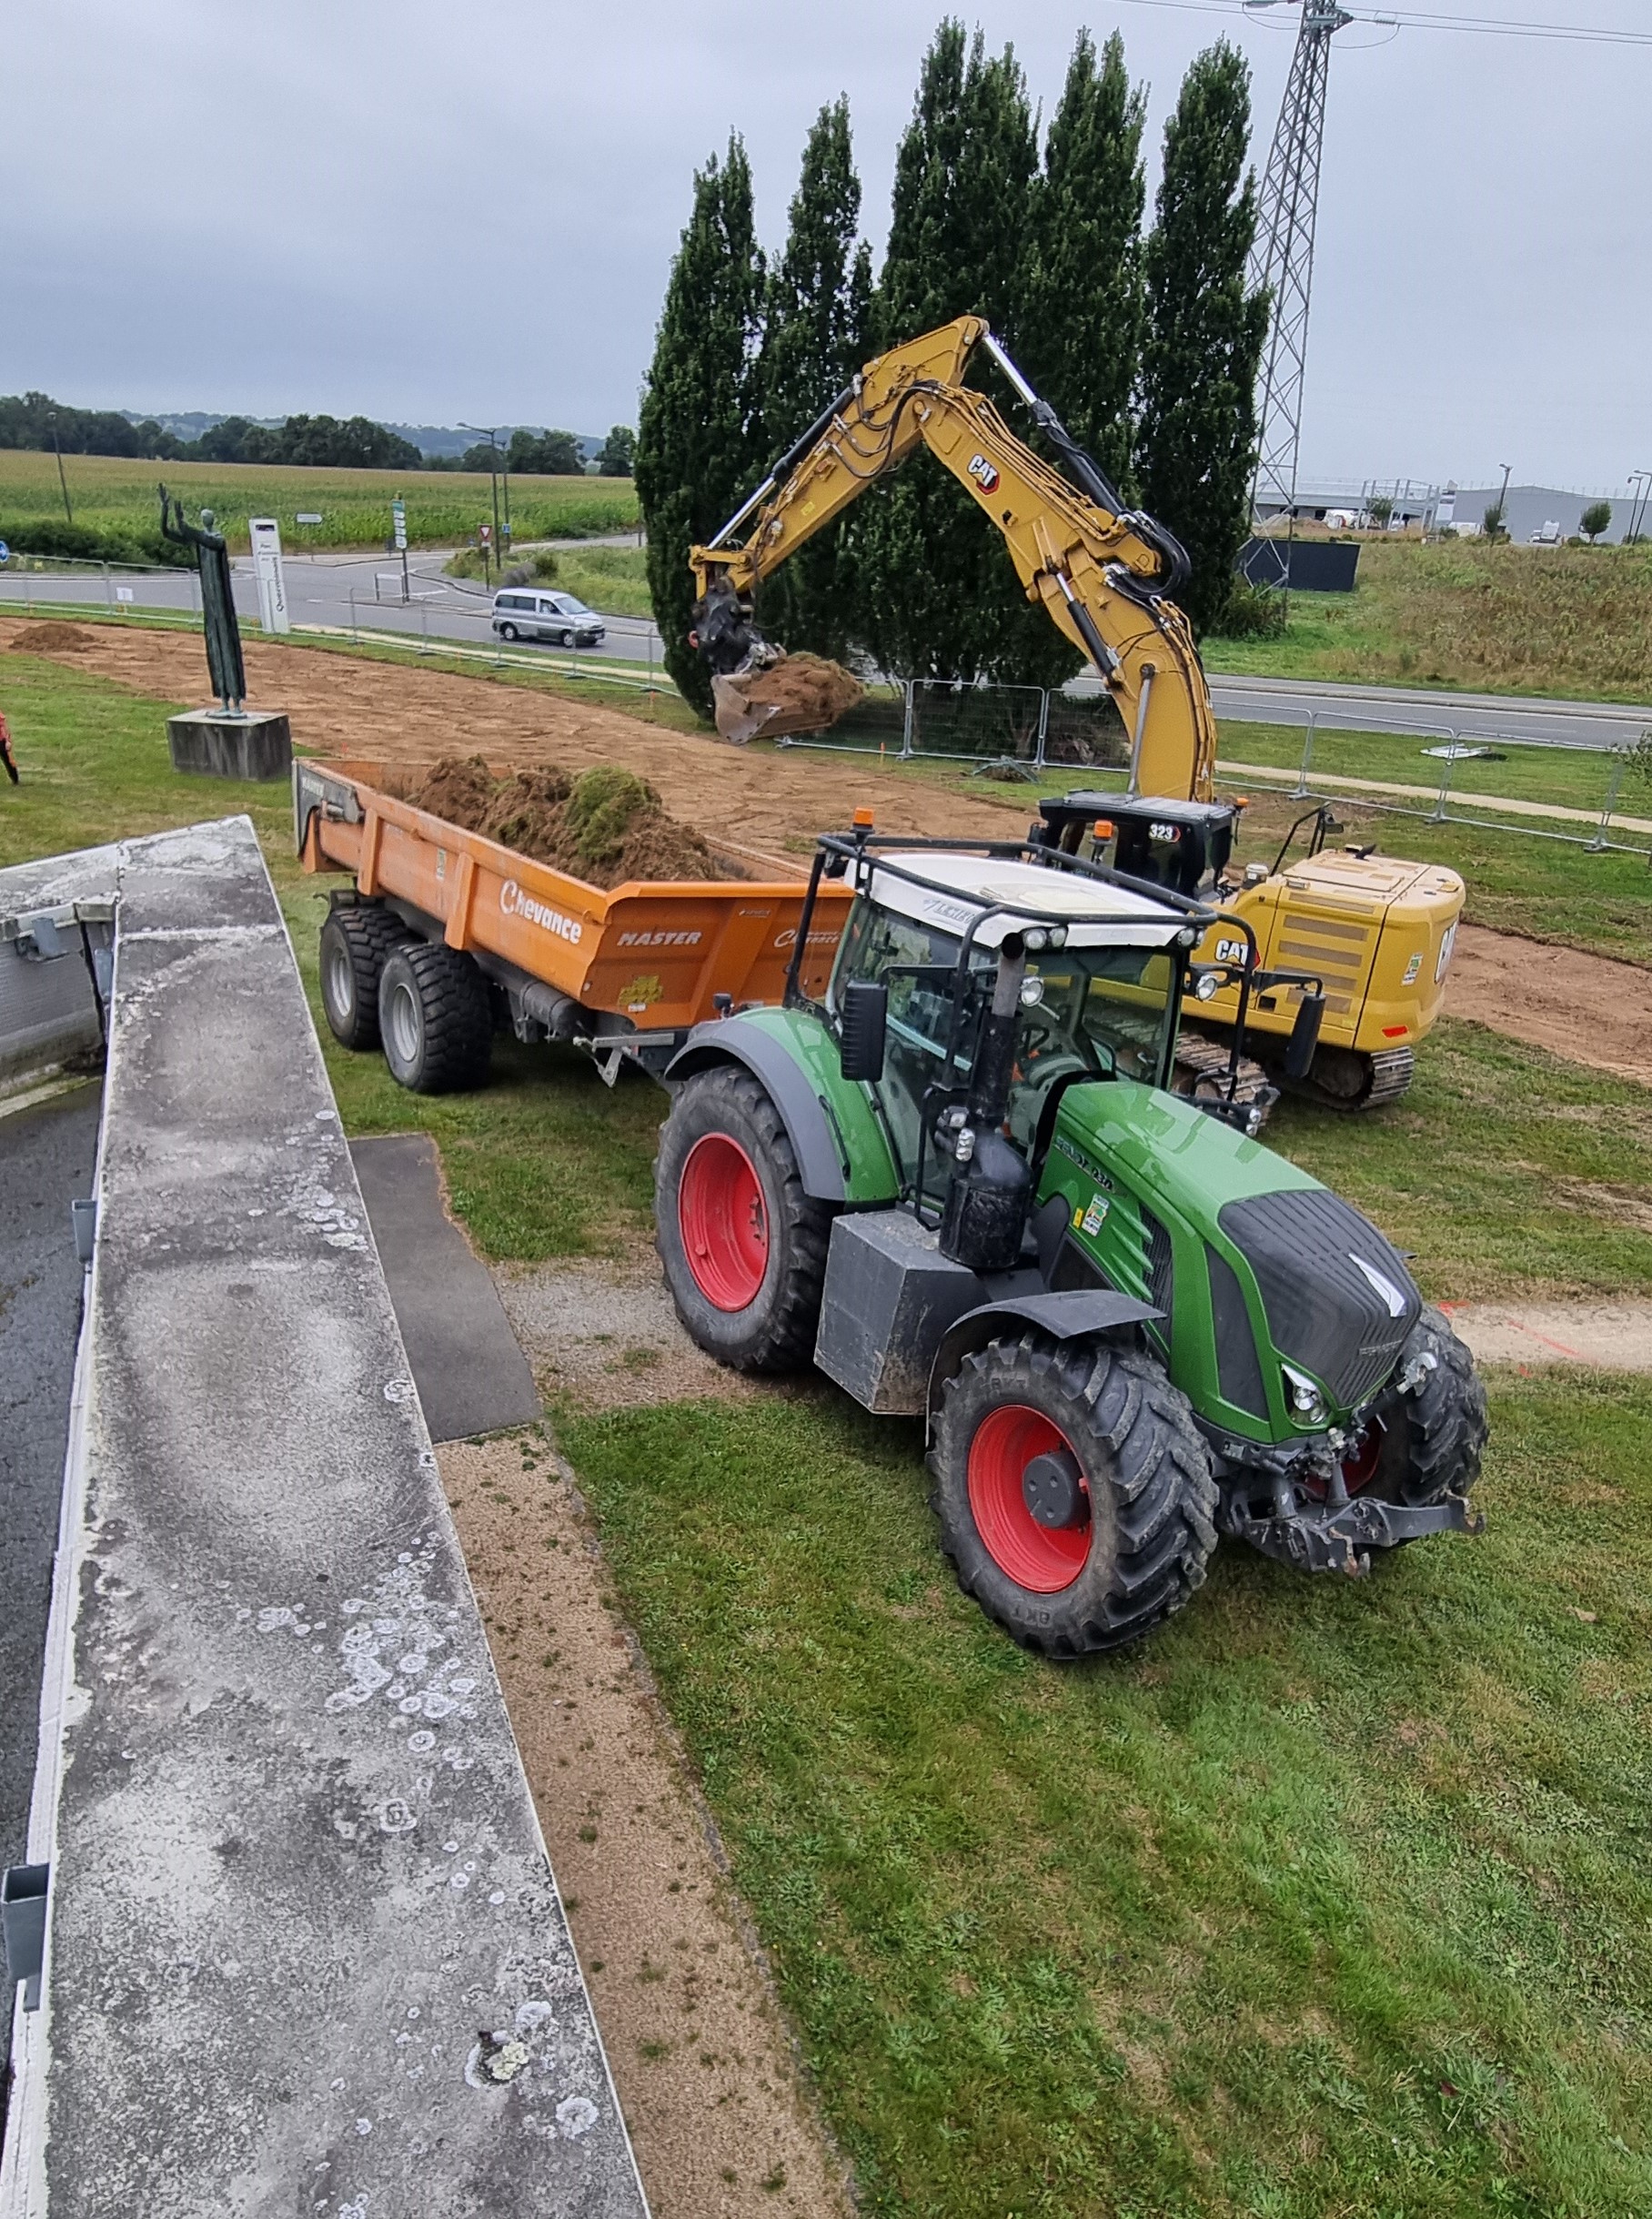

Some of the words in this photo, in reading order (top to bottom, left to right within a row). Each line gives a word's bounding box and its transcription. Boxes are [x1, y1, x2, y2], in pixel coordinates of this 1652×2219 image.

[968, 455, 998, 487] CAT
[1148, 823, 1174, 840] 323
[499, 879, 582, 944] Chevance
[617, 932, 701, 946] MASTER
[1215, 939, 1249, 966] CAT
